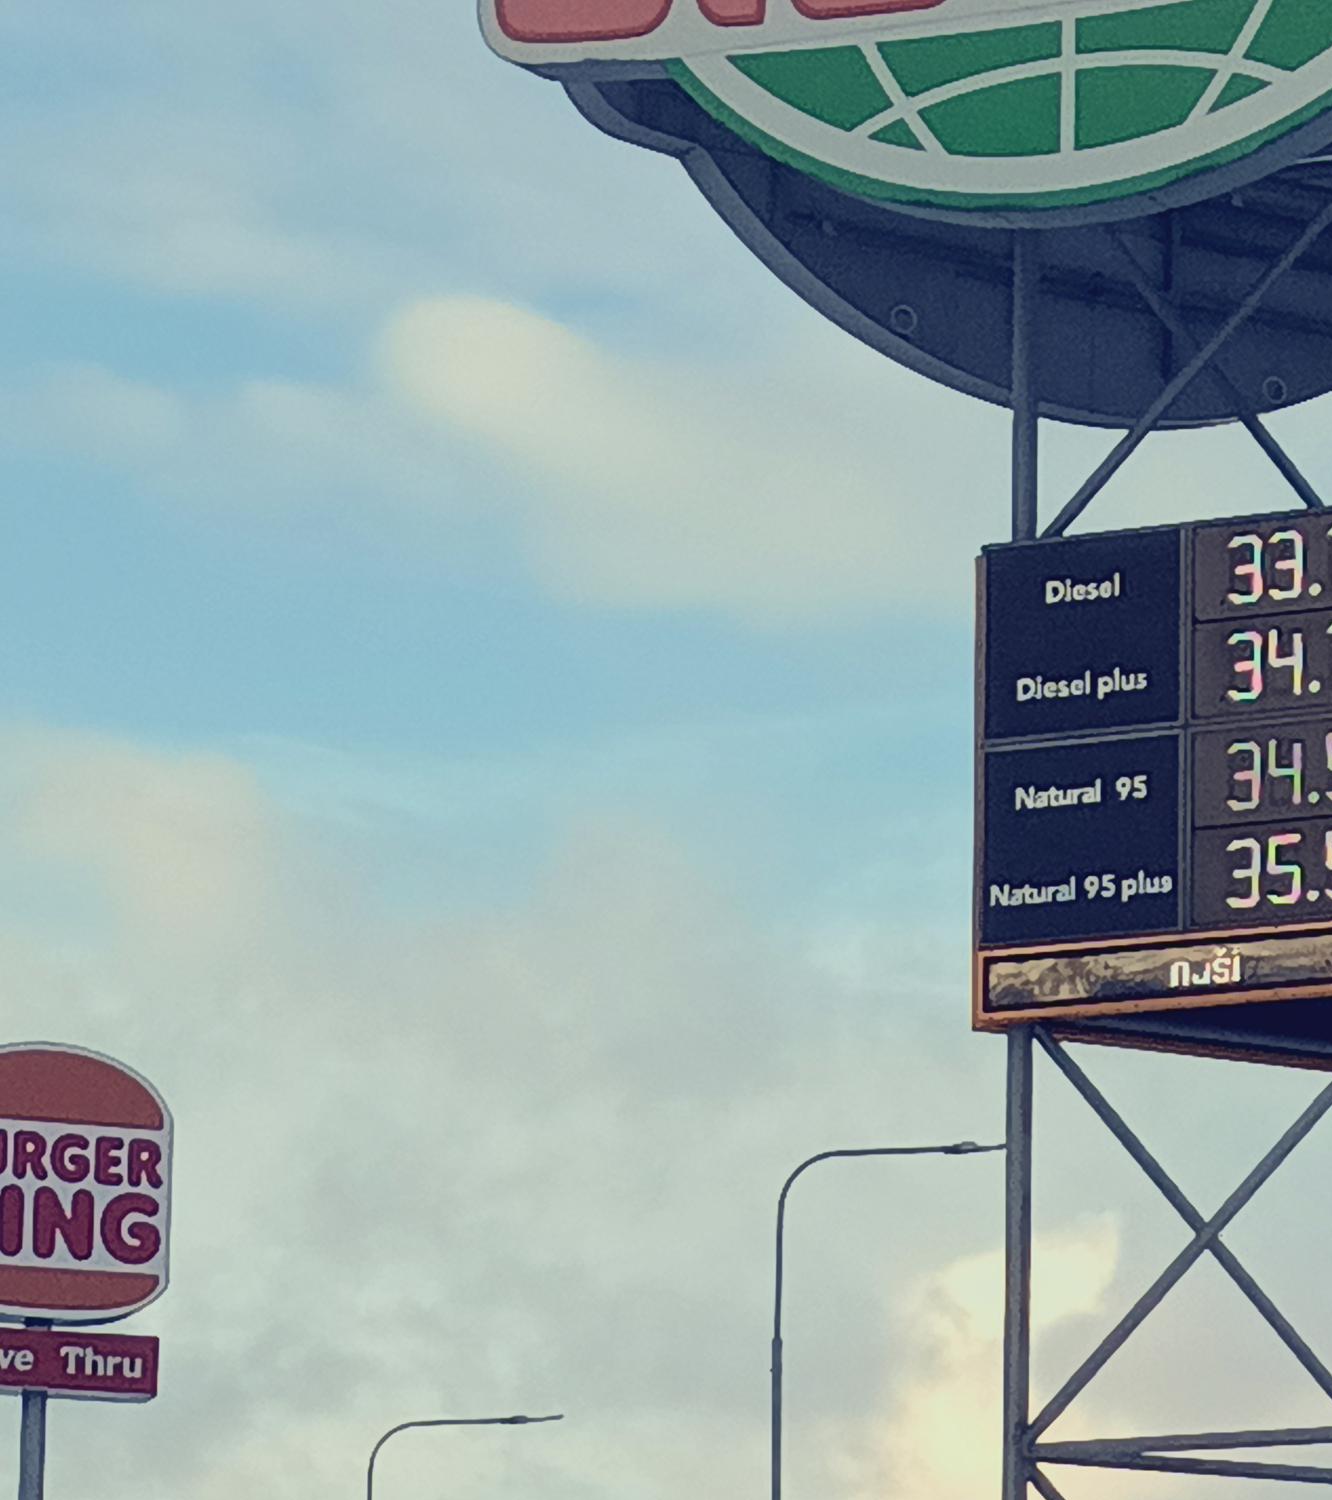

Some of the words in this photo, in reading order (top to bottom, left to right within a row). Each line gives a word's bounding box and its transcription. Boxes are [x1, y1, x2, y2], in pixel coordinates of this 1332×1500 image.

[1045, 572, 1121, 605] Diesel
[1016, 669, 1091, 702] Diesel
[1097, 666, 1148, 701] plus
[1014, 777, 1102, 811] Natural
[1115, 774, 1148, 801] 95
[989, 875, 1076, 907] Natural
[1083, 873, 1116, 900] 95
[1121, 869, 1173, 903] plus
[0, 1128, 164, 1190] RGER
[0, 1183, 162, 1265] ING
[60, 1346, 143, 1379] Thru
